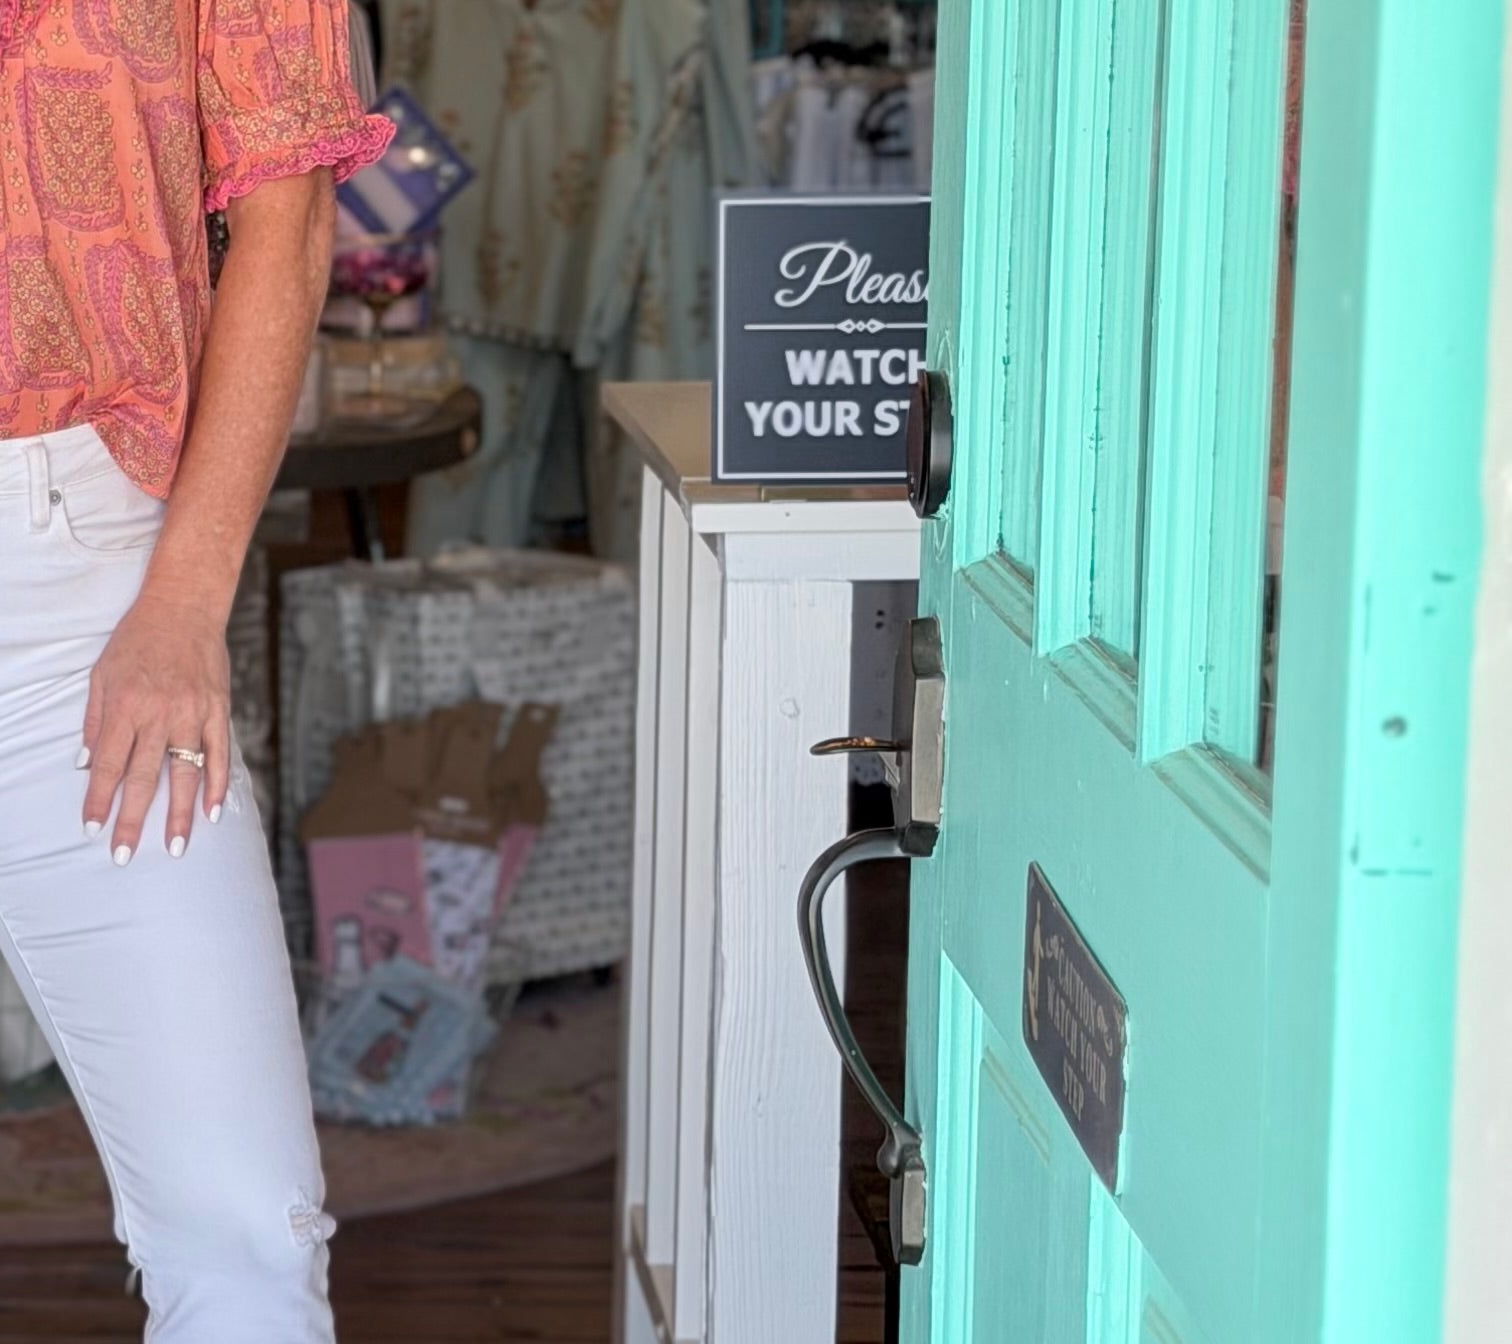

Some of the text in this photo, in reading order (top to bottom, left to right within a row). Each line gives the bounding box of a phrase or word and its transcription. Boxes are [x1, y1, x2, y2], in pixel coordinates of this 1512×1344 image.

[774, 240, 929, 308] Pleas
[744, 401, 863, 437] YOUR
[1058, 947, 1097, 1038] CAUTION
[1047, 975, 1107, 1105] WATCH YOUR
[1063, 1056, 1085, 1122] STEP
